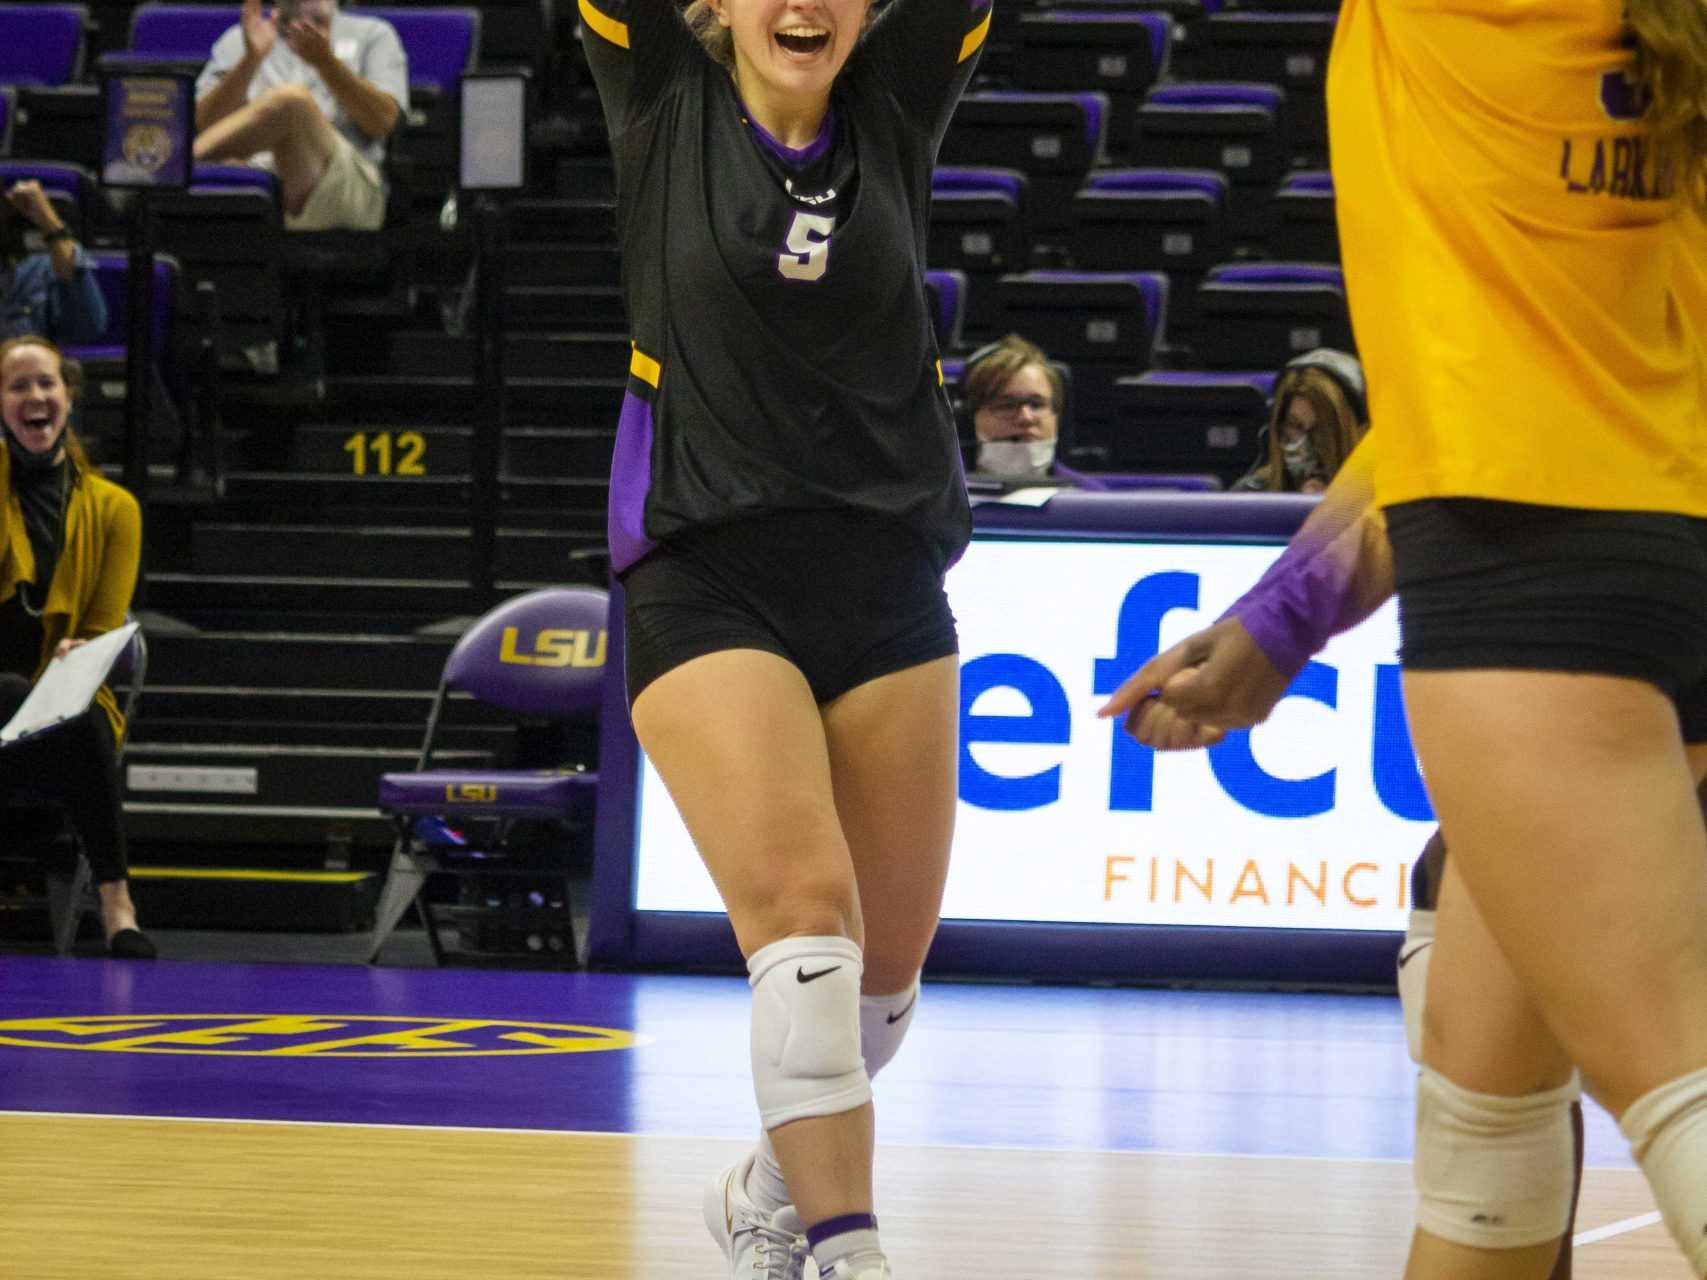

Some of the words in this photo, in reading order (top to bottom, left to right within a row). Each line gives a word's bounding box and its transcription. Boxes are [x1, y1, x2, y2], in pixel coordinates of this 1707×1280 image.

[778, 211, 836, 281] 5
[343, 431, 427, 476] 112
[500, 626, 608, 668] LSU
[446, 784, 497, 802] LSU
